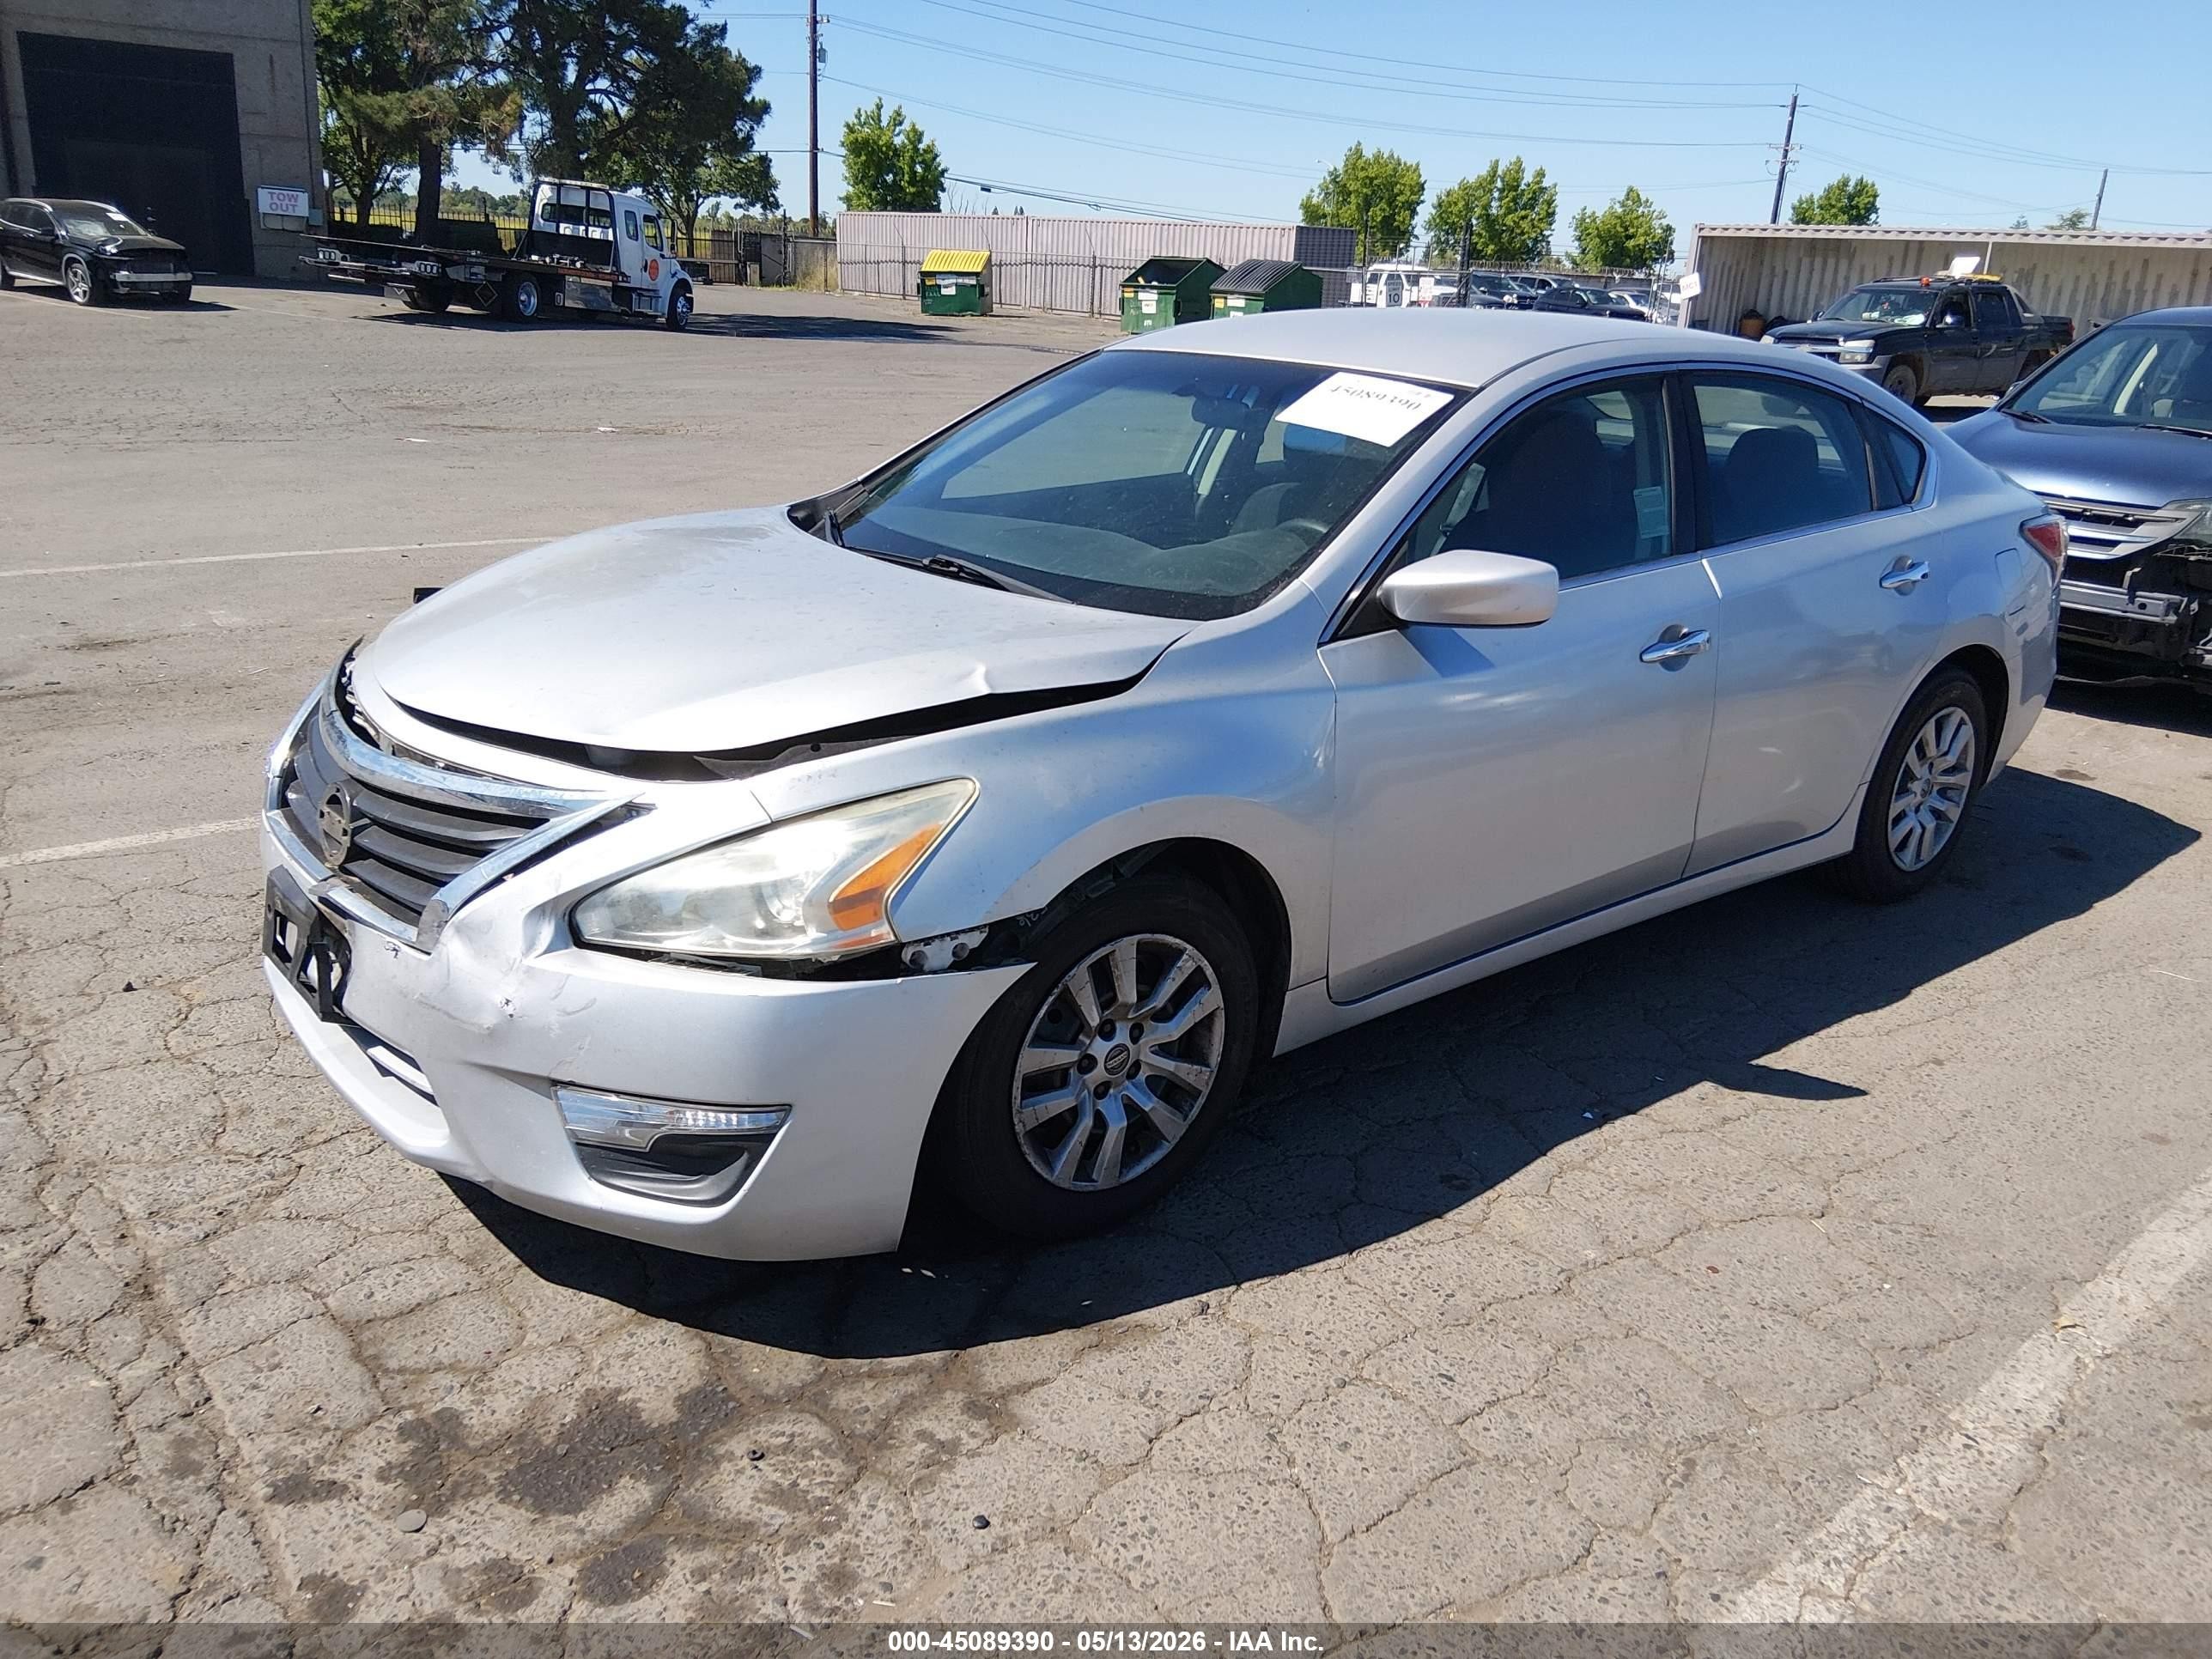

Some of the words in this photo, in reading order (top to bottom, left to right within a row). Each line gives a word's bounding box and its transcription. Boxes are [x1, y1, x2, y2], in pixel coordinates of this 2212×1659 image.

[268, 191, 299, 203] TOW
[269, 202, 298, 214] OUT
[1389, 293, 1400, 303] 10
